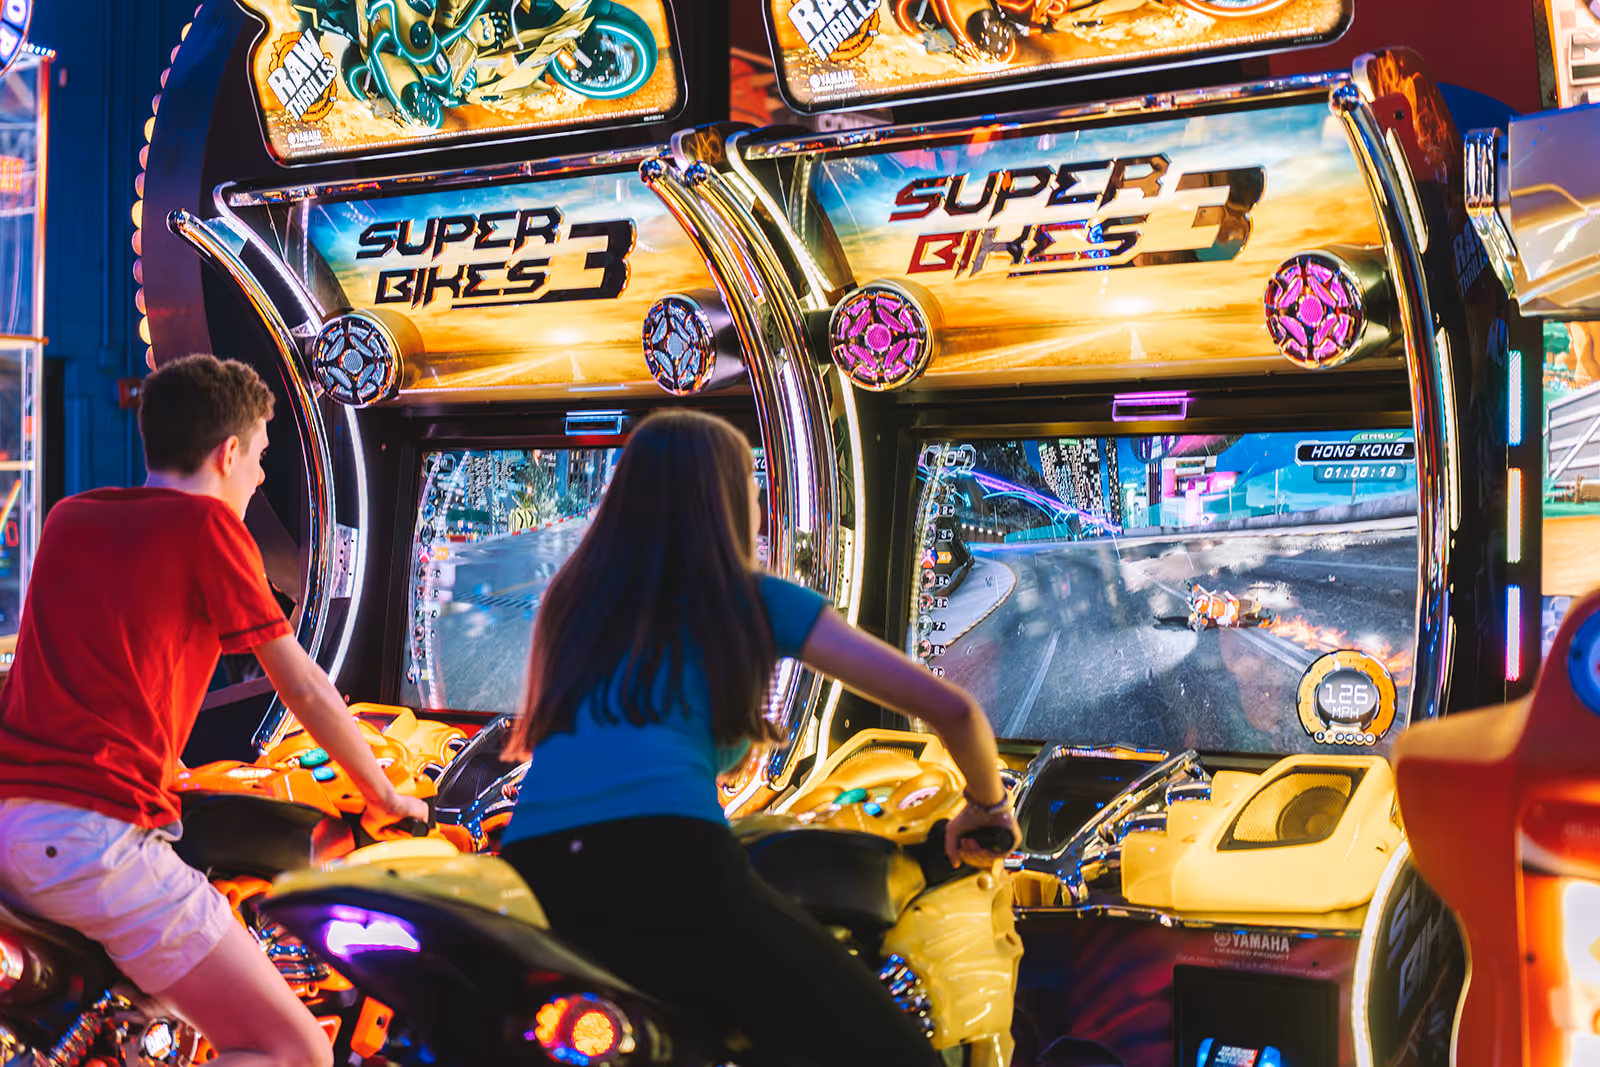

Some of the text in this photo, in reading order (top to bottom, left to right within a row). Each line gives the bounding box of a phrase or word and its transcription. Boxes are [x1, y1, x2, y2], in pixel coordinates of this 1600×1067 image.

[267, 27, 324, 107] RAW
[285, 57, 337, 122] THRILLS
[889, 152, 1170, 222] SUPER
[1172, 163, 1267, 264] 3
[355, 205, 565, 261] SUPER
[565, 217, 637, 300] 3
[906, 214, 1149, 280] BIKES
[374, 257, 551, 310] BIKES
[1311, 443, 1405, 458] HONG KONG
[1324, 683, 1368, 704] 126
[1331, 705, 1359, 719] MPH
[1233, 933, 1290, 952] YAMAHA
